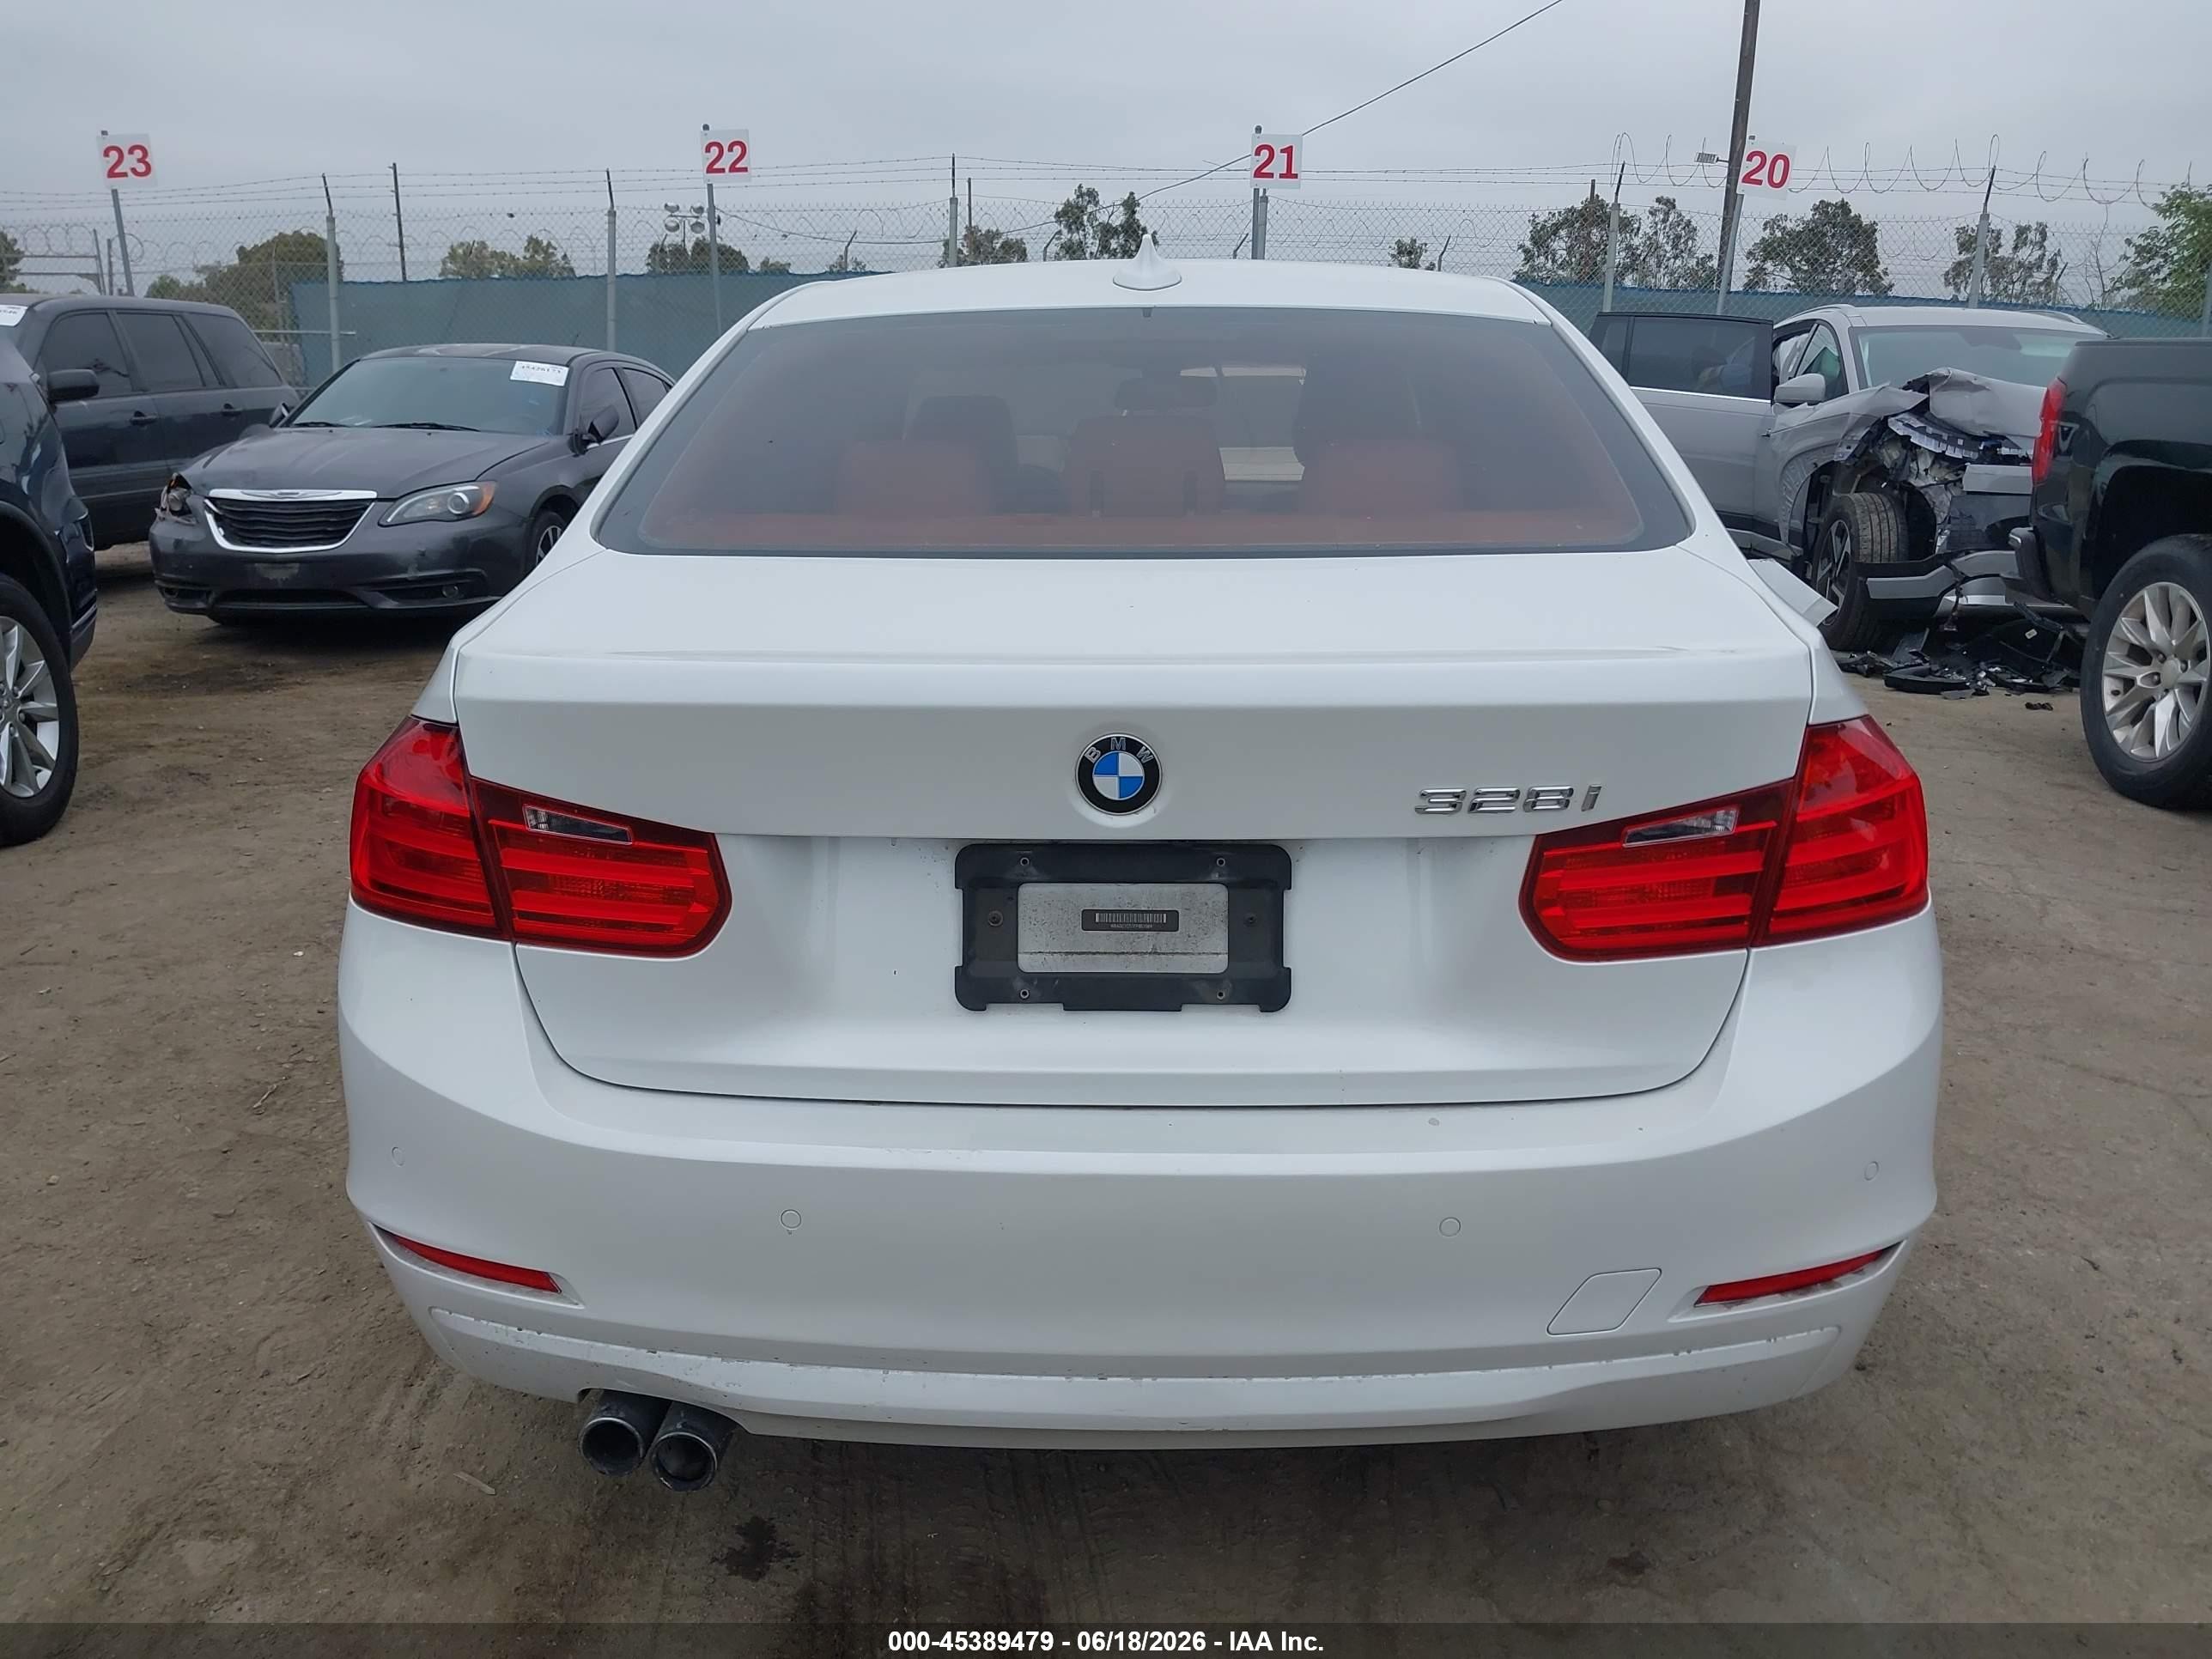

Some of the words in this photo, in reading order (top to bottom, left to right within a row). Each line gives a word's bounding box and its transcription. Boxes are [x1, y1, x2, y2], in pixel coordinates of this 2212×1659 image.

[104, 145, 151, 179] 23
[705, 141, 748, 173] 22
[1254, 144, 1297, 179] 21
[1742, 149, 1790, 187] 20
[1085, 737, 1154, 763] BMW
[1414, 784, 1602, 815] 328i
